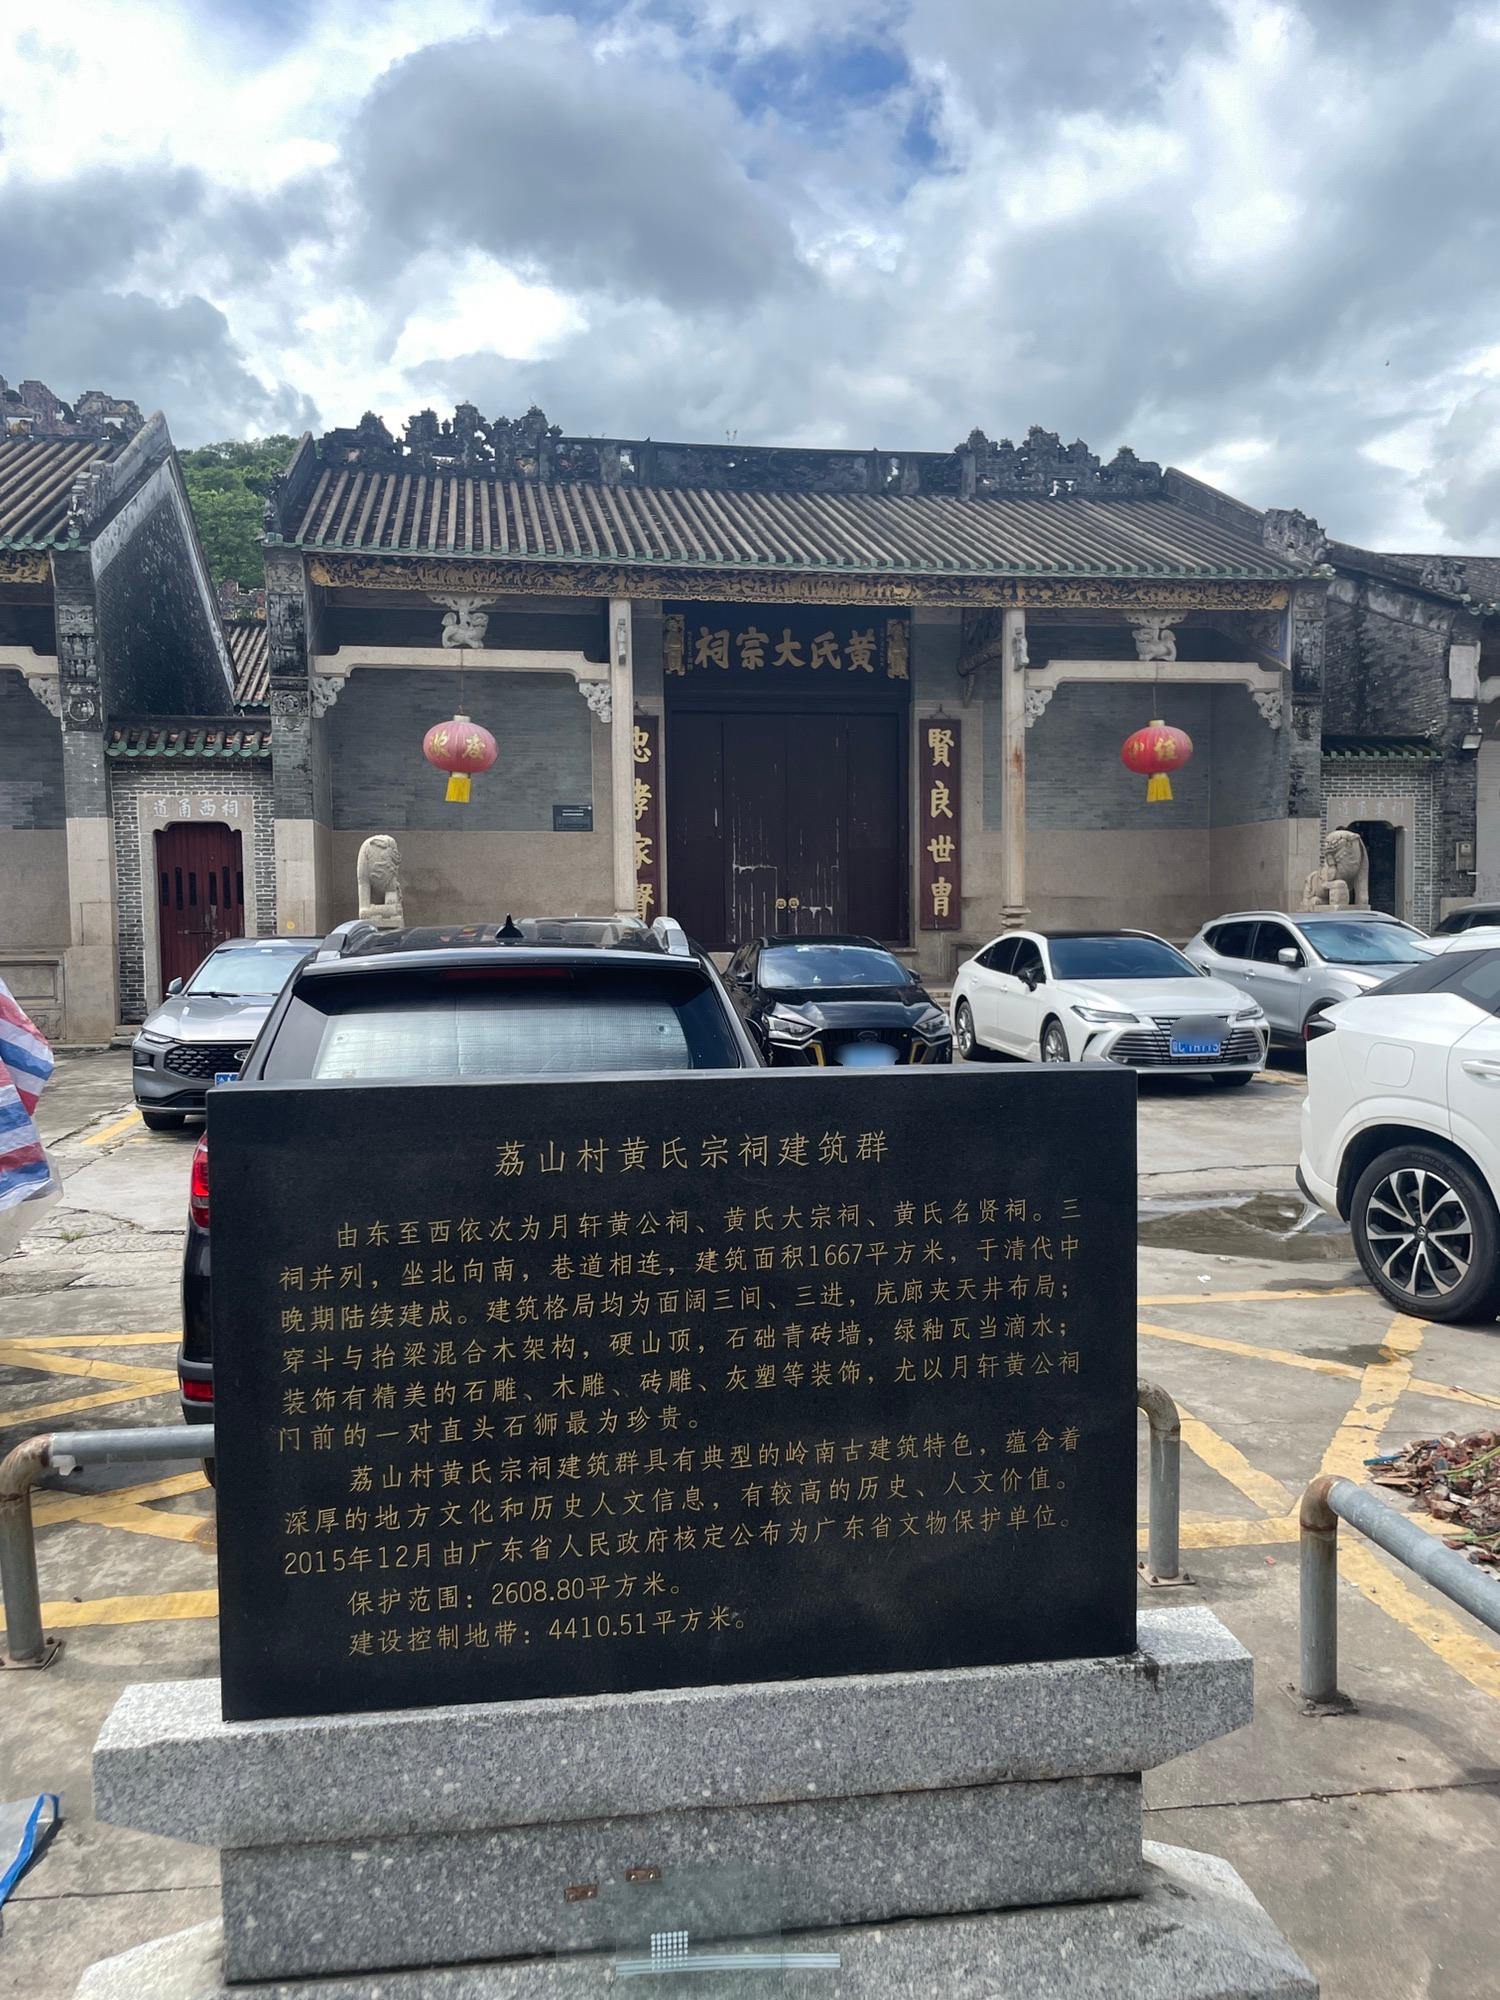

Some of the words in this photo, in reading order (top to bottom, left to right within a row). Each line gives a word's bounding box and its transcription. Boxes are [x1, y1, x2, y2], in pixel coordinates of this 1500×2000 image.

[494, 1129, 890, 1177] 荔山村黄氏宗祠建筑群
[278, 1403, 699, 1452] 门前的一对直头石狮最为珍贵。
